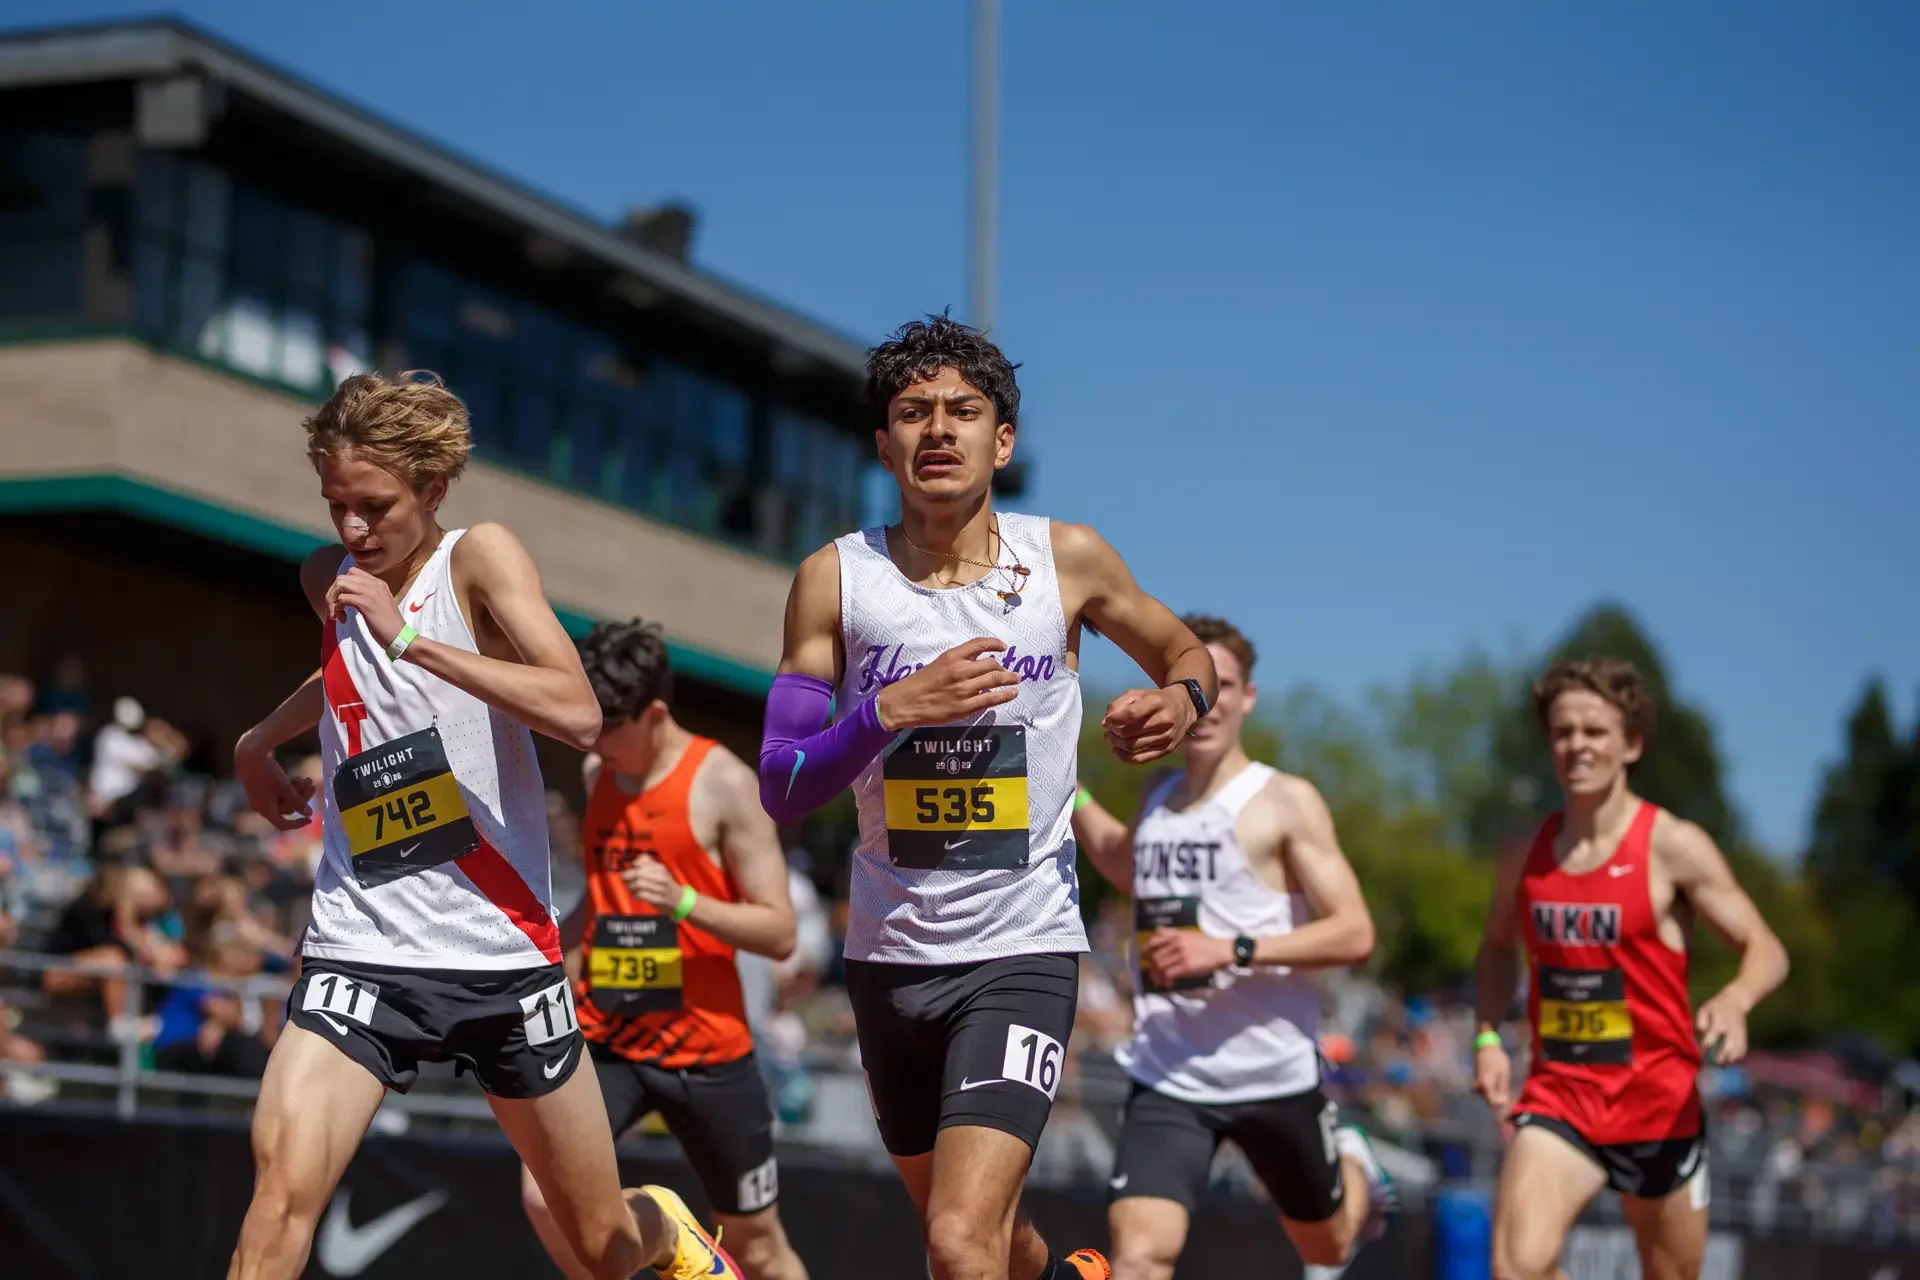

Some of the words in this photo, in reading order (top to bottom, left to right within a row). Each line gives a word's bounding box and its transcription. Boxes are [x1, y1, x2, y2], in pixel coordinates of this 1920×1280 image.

[859, 642, 1055, 693] Heton
[352, 747, 414, 780] TWILIGHT
[913, 739, 993, 754] TWILIGHT
[367, 790, 437, 841] 742
[915, 786, 995, 824] 535
[320, 975, 363, 1016] 11
[533, 984, 573, 1038] 11
[1020, 1033, 1060, 1093] 16
